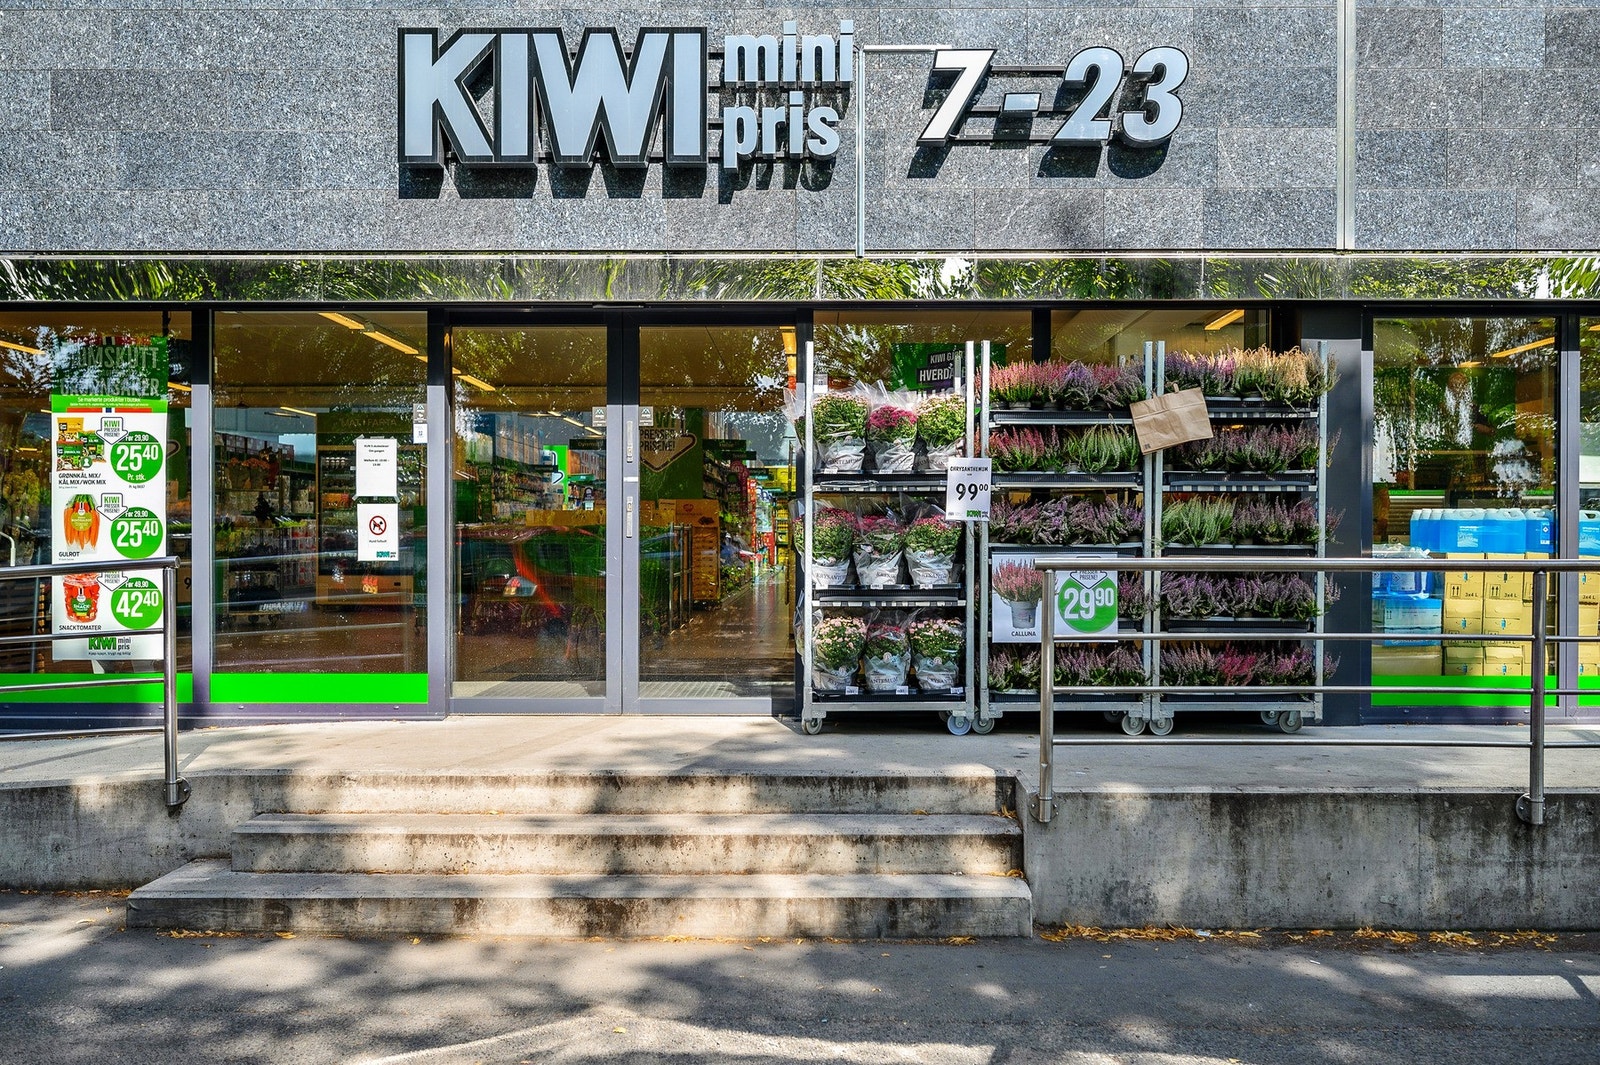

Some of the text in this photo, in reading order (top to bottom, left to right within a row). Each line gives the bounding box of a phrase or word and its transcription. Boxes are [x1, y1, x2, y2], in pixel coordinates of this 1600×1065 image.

[724, 20, 854, 84] mini
[399, 27, 707, 163] KIWI
[916, 48, 998, 146] 7
[1052, 46, 1190, 146] 23
[723, 91, 841, 169] pris
[930, 353, 946, 364] KIWI
[103, 420, 120, 428] KIWI
[88, 636, 117, 650] KIWI
[117, 643, 130, 651] pris
